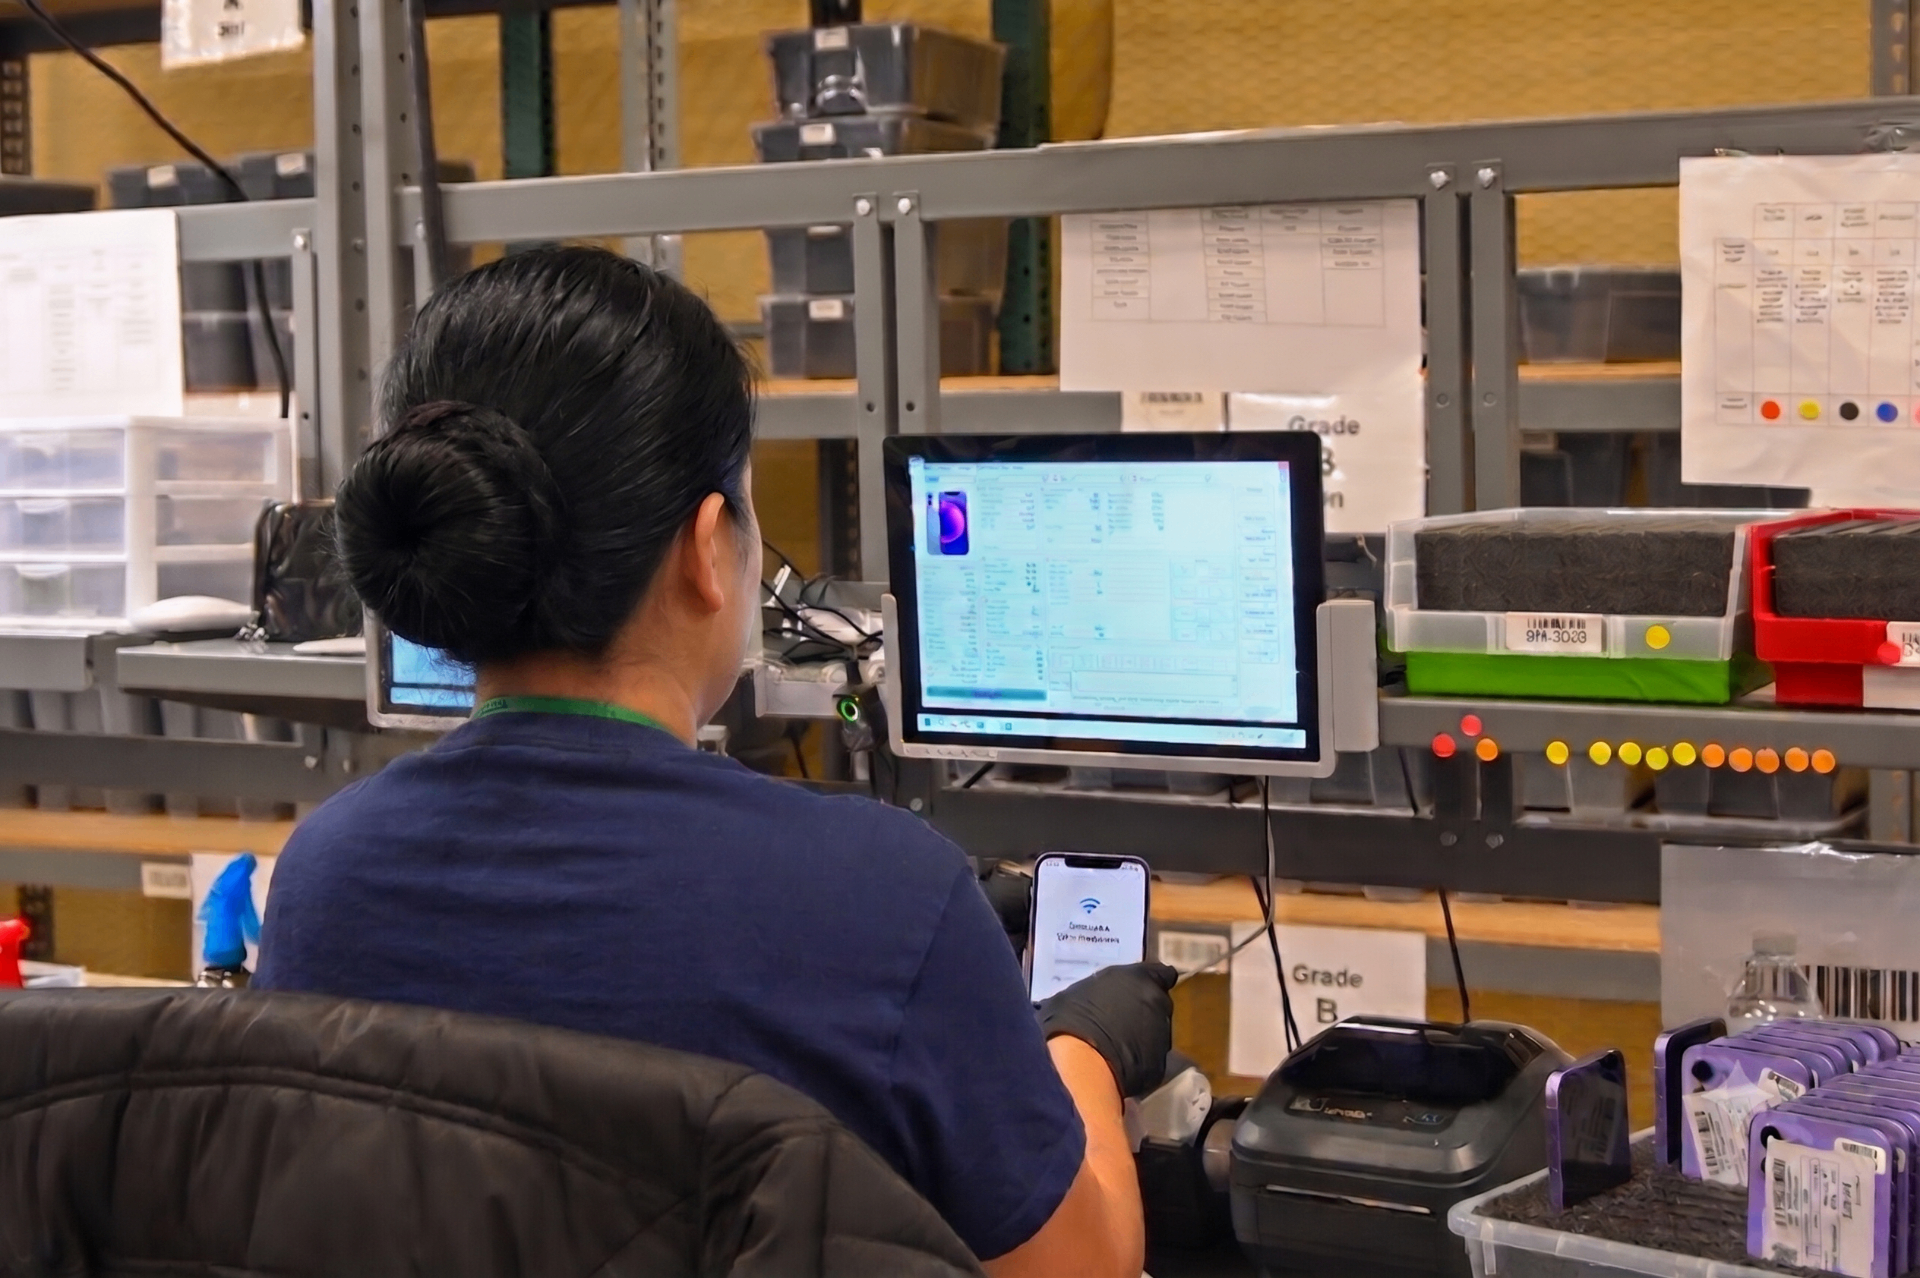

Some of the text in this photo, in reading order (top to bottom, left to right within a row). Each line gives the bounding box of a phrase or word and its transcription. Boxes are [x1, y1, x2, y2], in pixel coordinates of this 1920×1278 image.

[1288, 414, 1360, 435] Grade
[1293, 963, 1363, 987] Grade
[1316, 998, 1338, 1023] B
